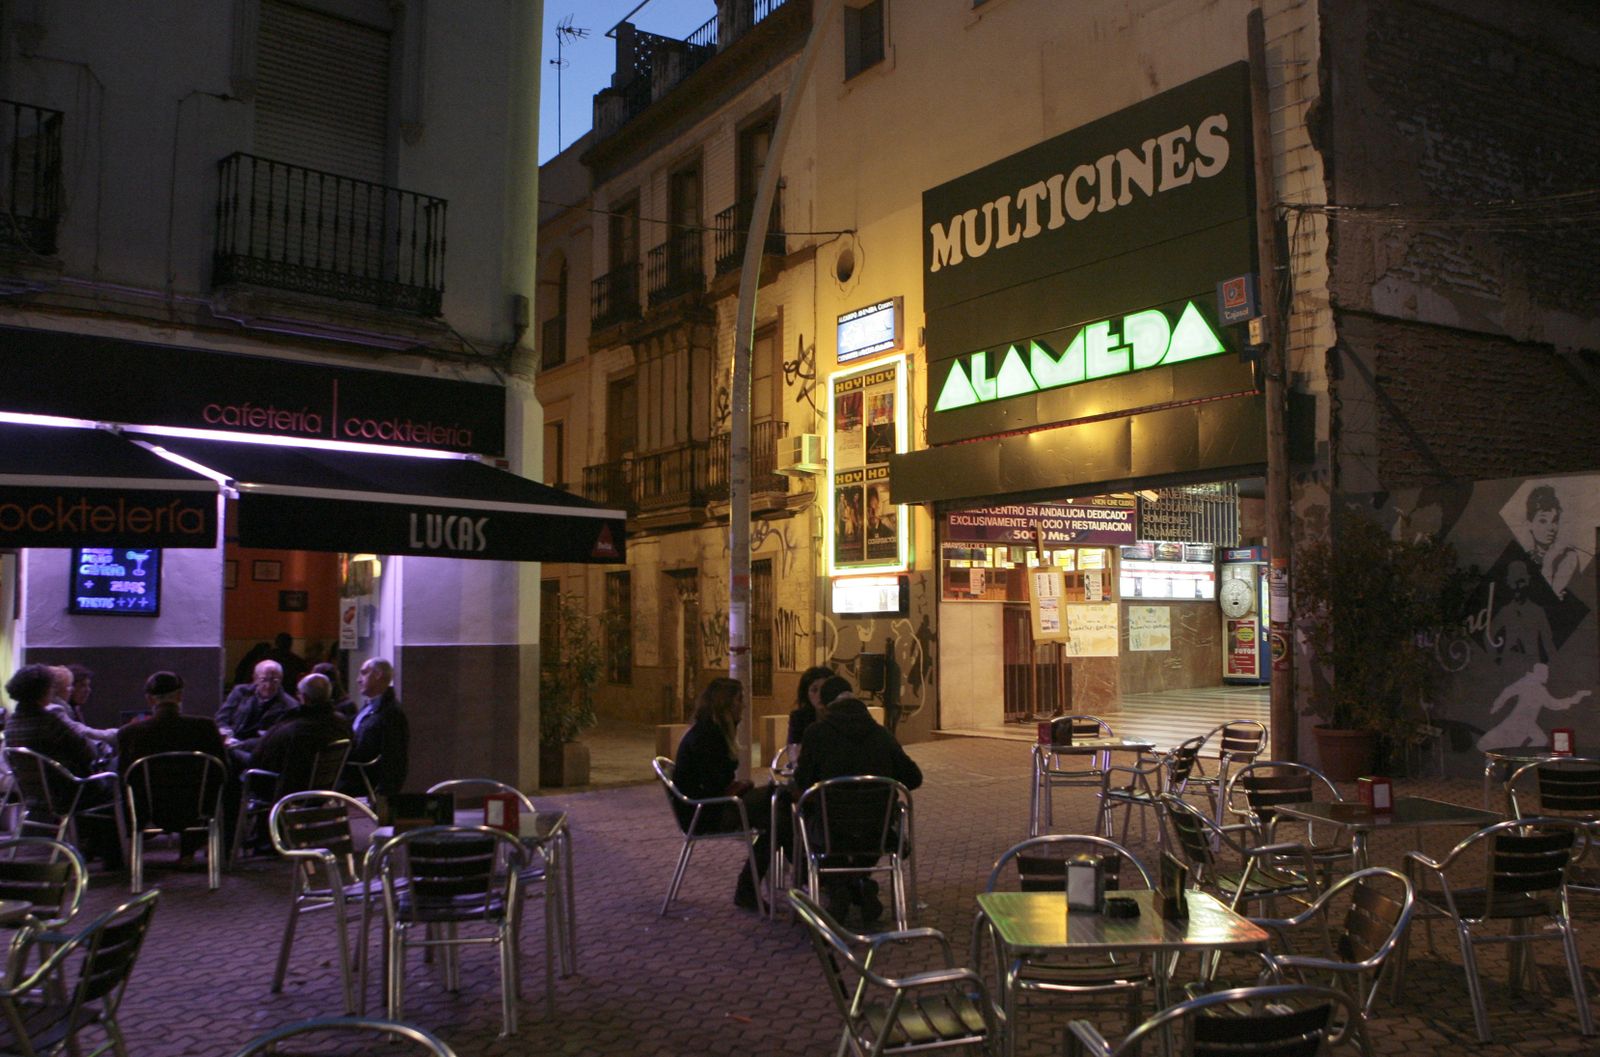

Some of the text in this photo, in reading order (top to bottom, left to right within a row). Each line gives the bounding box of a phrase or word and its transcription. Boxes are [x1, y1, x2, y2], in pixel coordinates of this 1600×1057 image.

[930, 113, 1230, 273] MULTICINES
[934, 300, 1226, 412] ALAMEDA
[836, 377, 862, 393] HOY
[866, 370, 895, 385] HOY
[202, 402, 322, 434] cafetería
[835, 471, 863, 484] HOY
[867, 467, 889, 479] HO
[989, 505, 1025, 515] CENTRO
[1026, 506, 1039, 516] EN
[1040, 507, 1086, 518] ANDALUCIA
[1087, 509, 1128, 521] DEDICADO
[950, 515, 1028, 528] EXCLUSIVAMENTE
[1042, 519, 1064, 529] OCIO
[1064, 520, 1071, 529] Y
[1071, 520, 1132, 532] RESTAURACION
[409, 512, 490, 552] LUCAS
